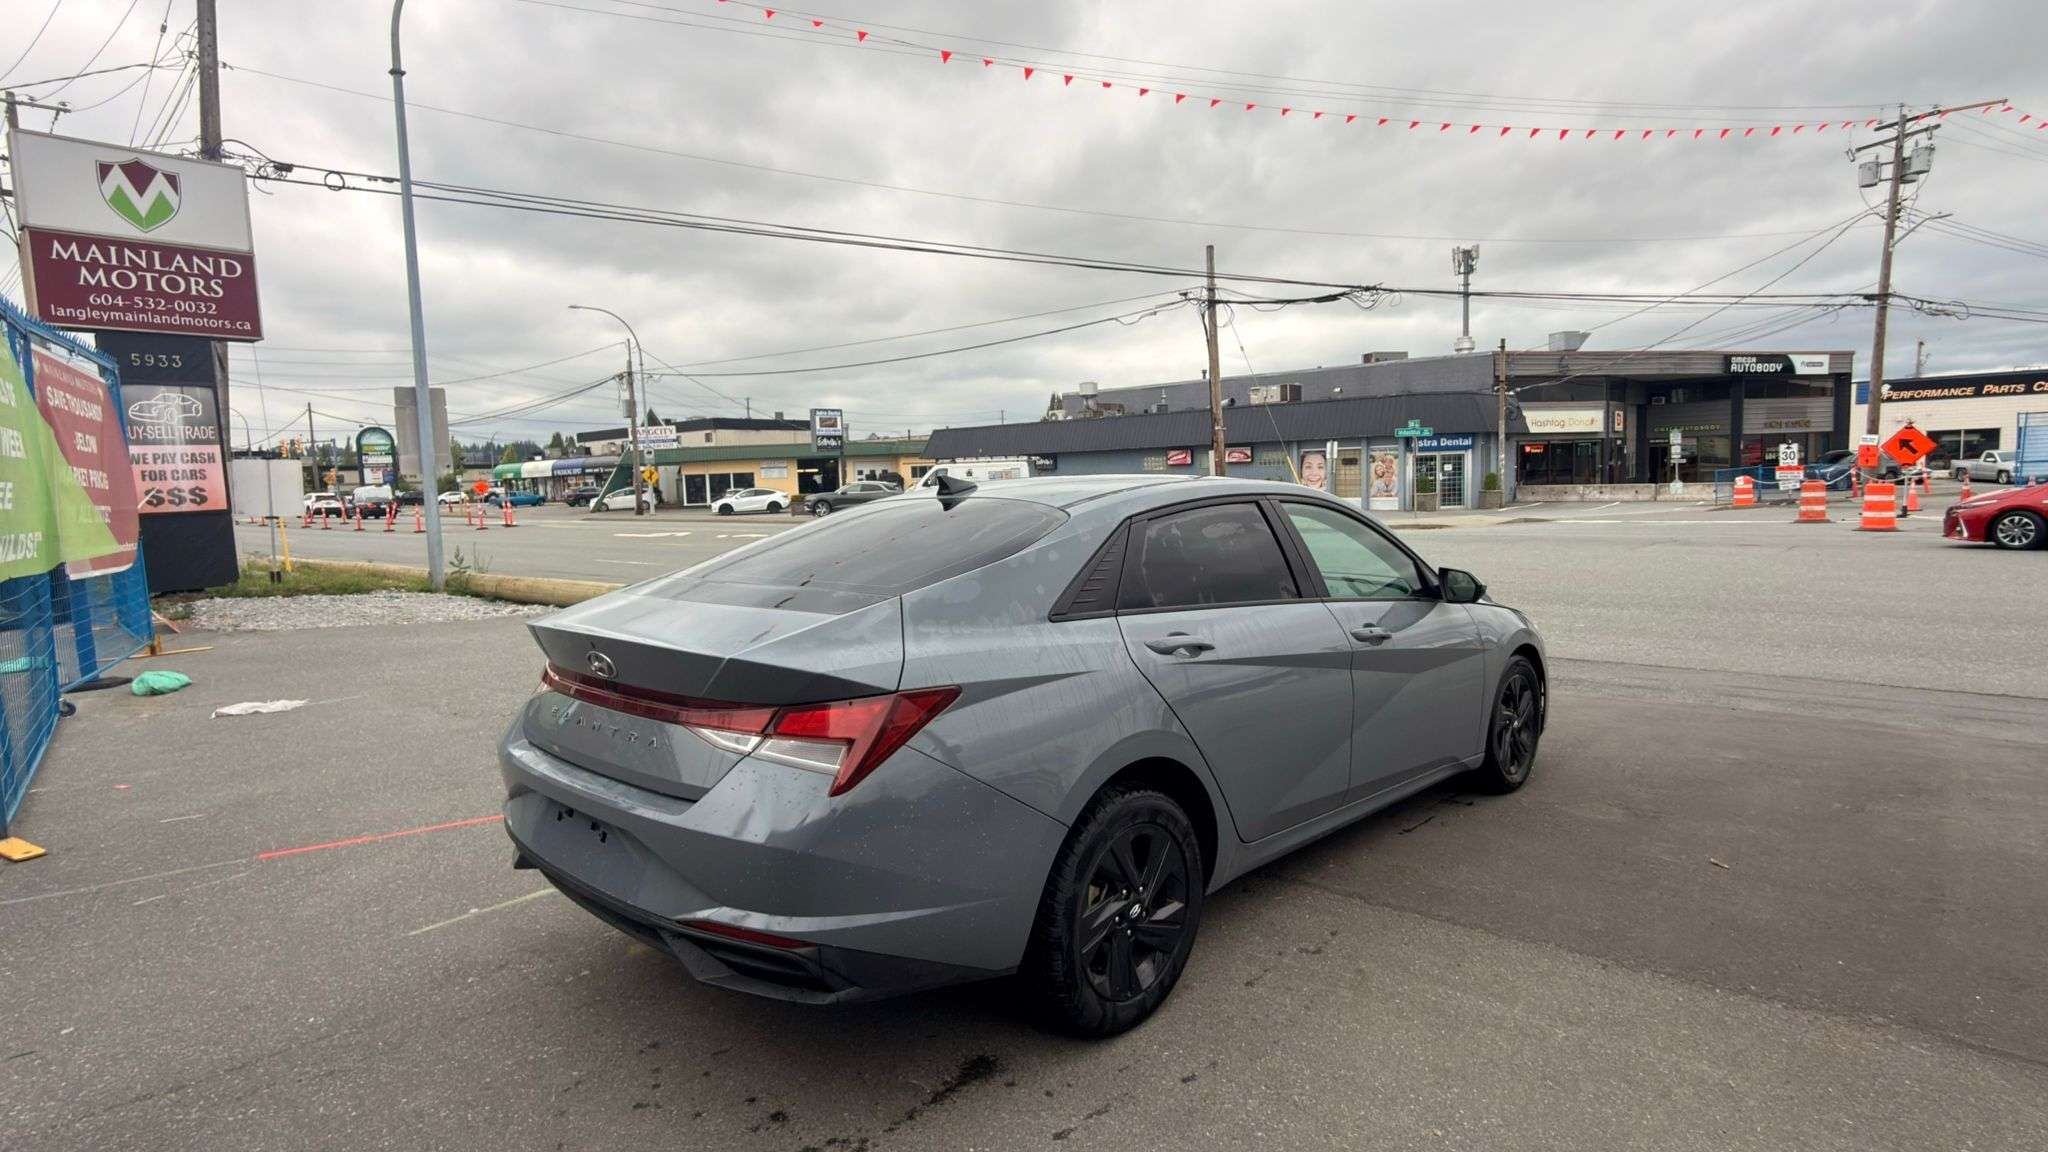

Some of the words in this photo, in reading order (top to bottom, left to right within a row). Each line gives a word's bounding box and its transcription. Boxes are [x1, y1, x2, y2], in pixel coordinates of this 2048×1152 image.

[51, 240, 241, 278] MAINLAND
[78, 267, 224, 298] MOTORS
[89, 294, 217, 315] 604-532-0032
[51, 304, 252, 330] langleymainlandmotors.ca
[131, 353, 182, 368] 5933
[1730, 363, 1783, 373] AUTOBODY
[1884, 386, 1976, 400] PERFORMANCE
[1982, 383, 2026, 394] PARTS
[1531, 418, 1565, 428] Hashtag
[636, 428, 673, 436] ANGCITY
[1440, 437, 1472, 446] Dental
[152, 453, 176, 465] PAY
[180, 451, 216, 464] CASH
[1781, 450, 1796, 460] 30
[140, 469, 168, 482] FOR
[170, 468, 207, 481] CARS
[143, 486, 208, 508] $$$
